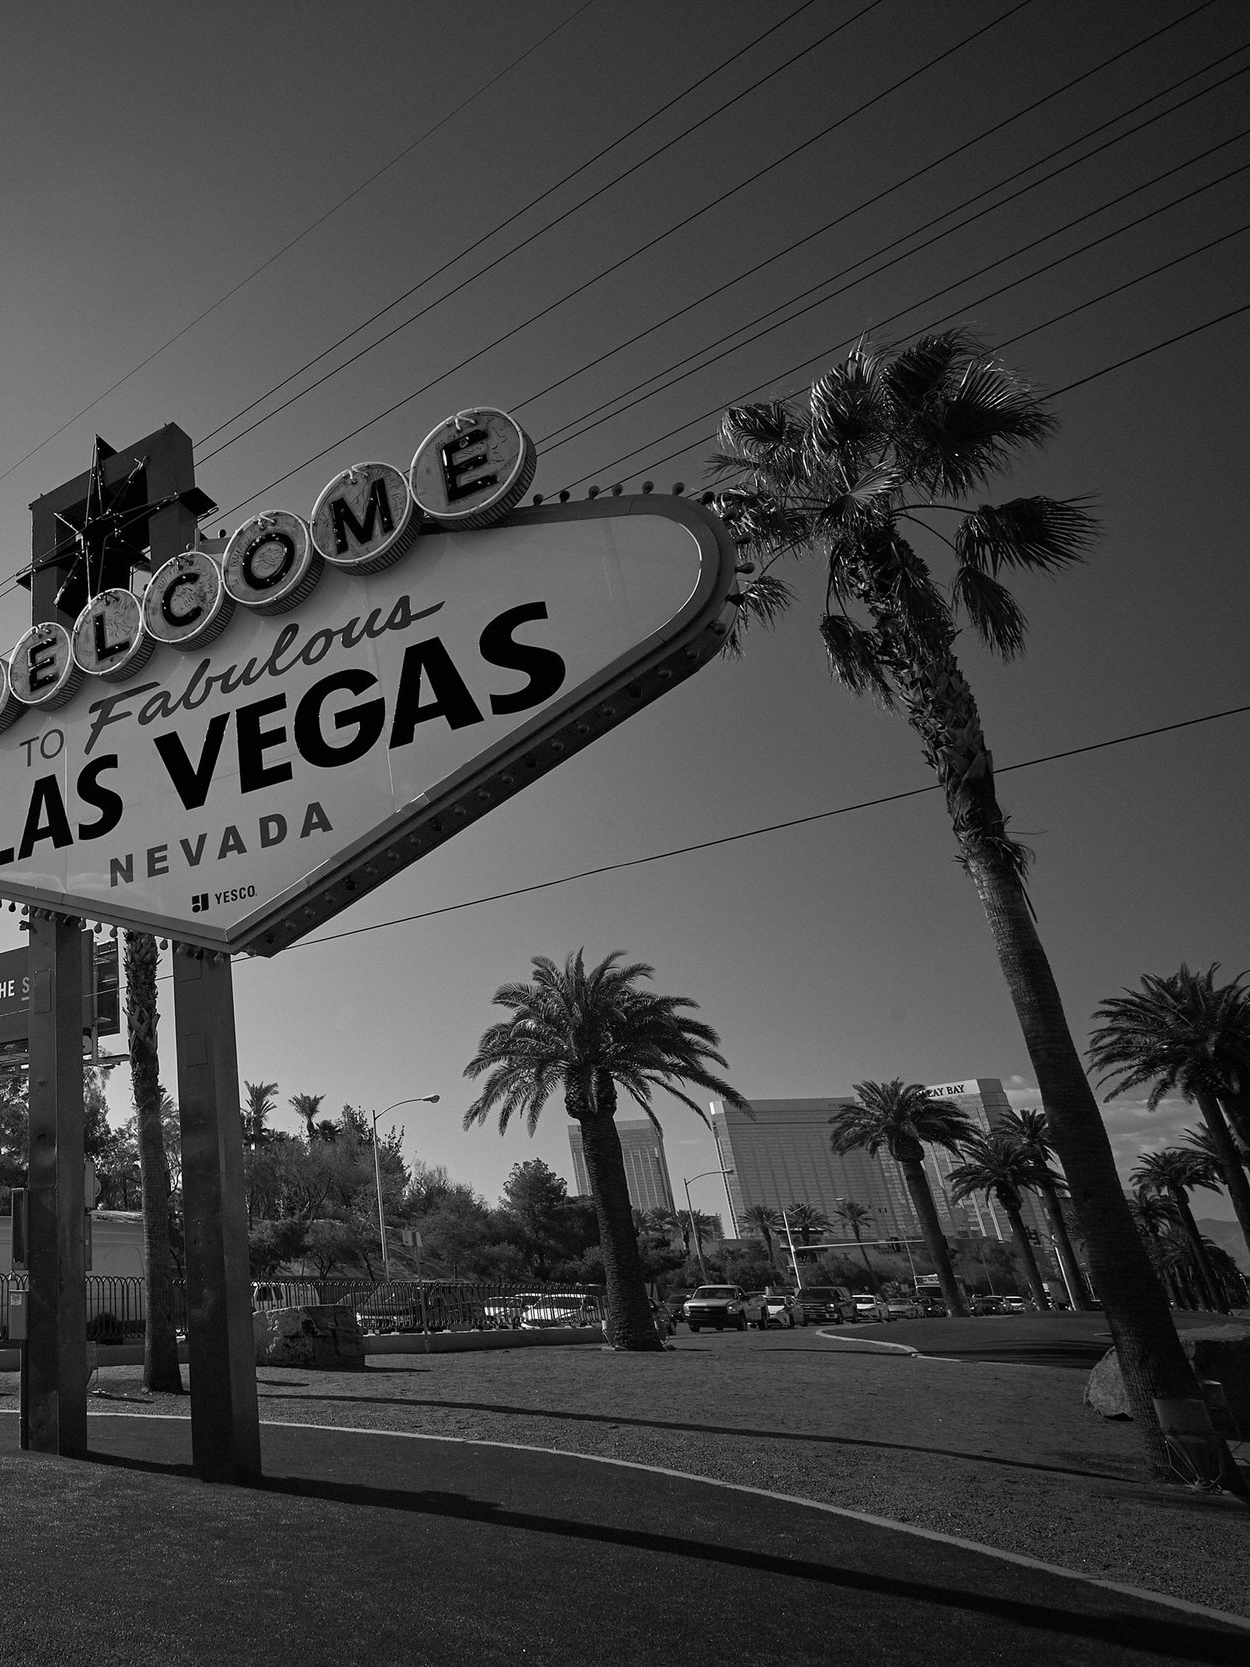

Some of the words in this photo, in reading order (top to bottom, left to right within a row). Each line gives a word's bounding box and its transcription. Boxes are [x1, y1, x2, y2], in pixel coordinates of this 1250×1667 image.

[20, 728, 65, 768] TO
[84, 594, 446, 755] Fabulous
[152, 600, 566, 812] VEGAS
[108, 801, 334, 888] NEVADA
[214, 884, 256, 905] YESCO
[946, 1084, 965, 1095] BAY
